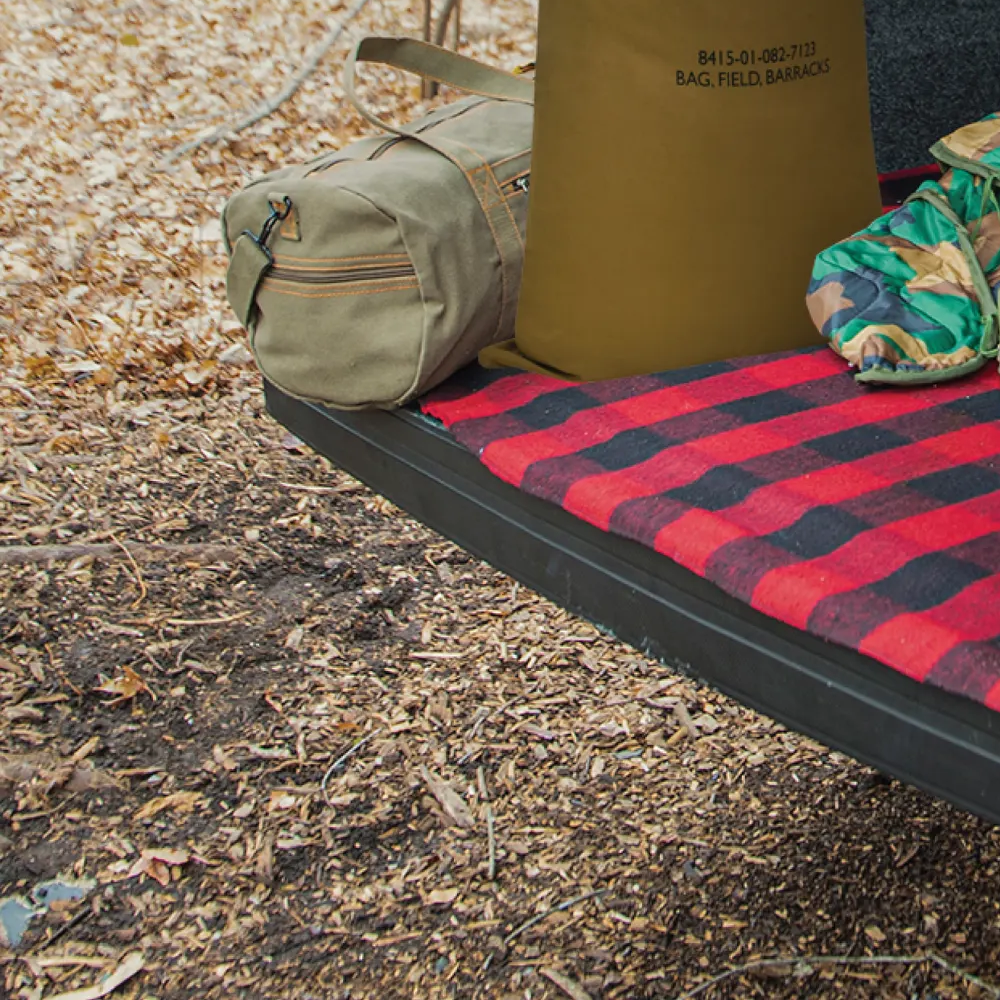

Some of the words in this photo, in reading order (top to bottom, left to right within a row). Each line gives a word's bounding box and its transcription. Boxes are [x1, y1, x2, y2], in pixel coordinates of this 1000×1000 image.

[698, 41, 816, 66] 8415-01-082-7123
[675, 70, 714, 88] BAG,
[718, 71, 763, 87] FIELD,
[766, 58, 831, 85] BARRACKS
